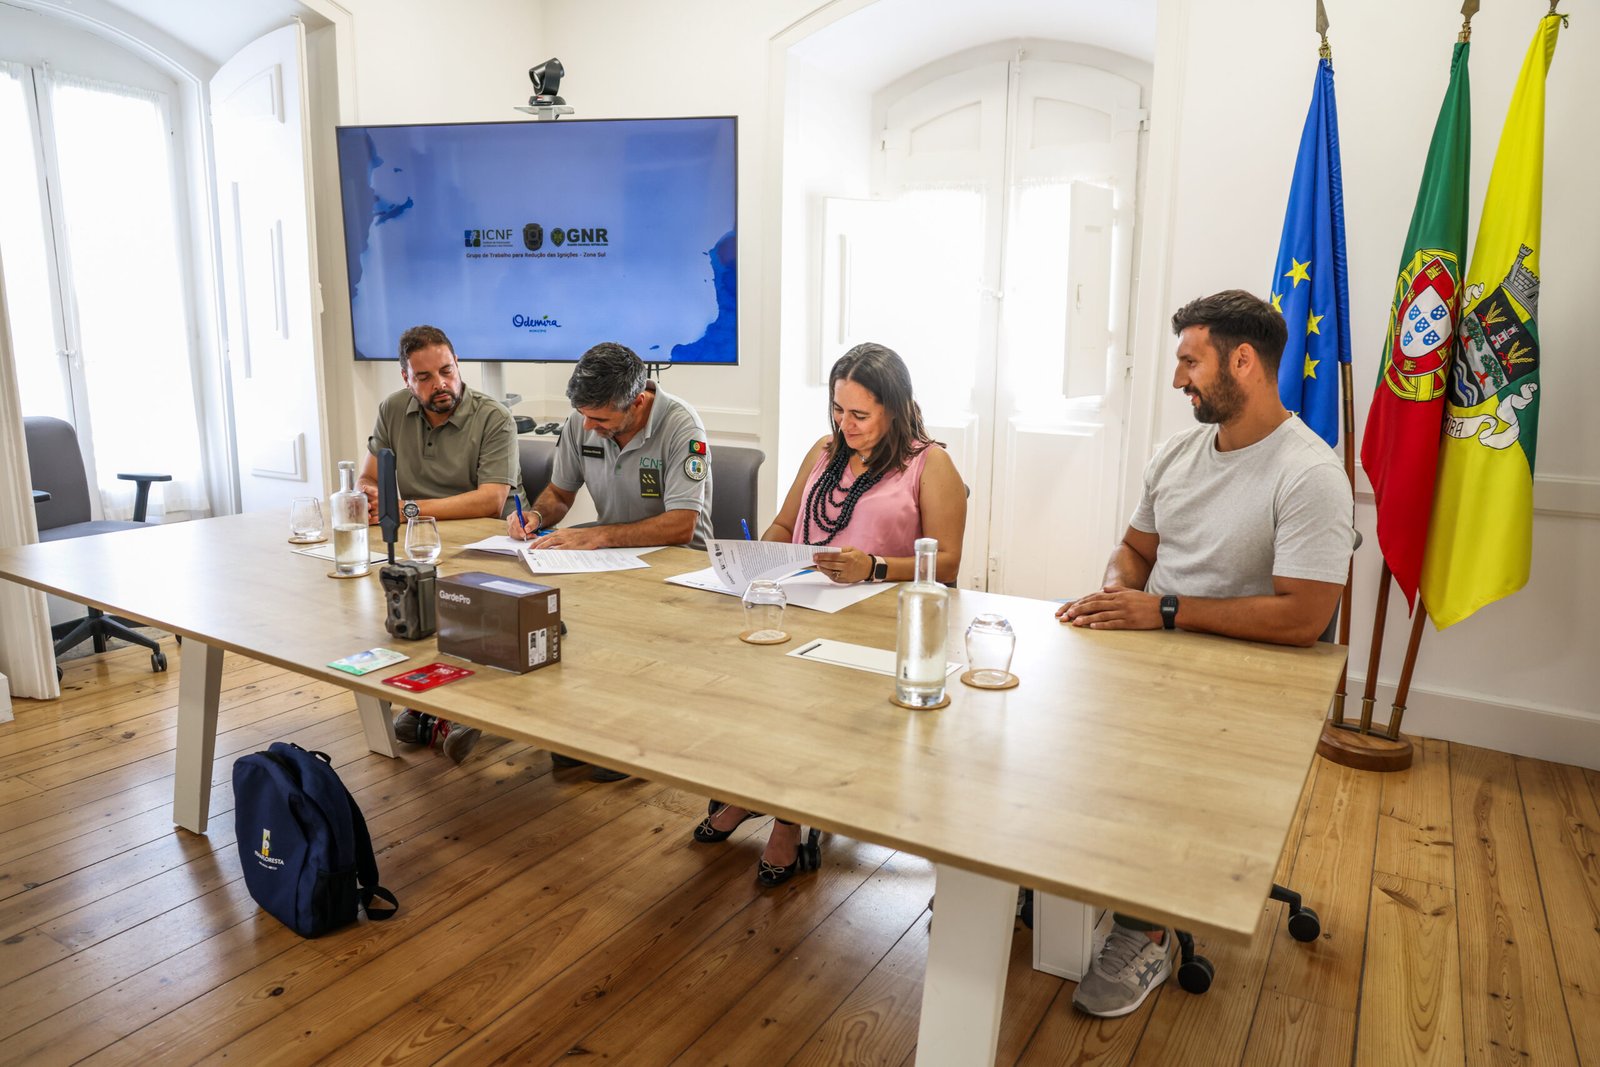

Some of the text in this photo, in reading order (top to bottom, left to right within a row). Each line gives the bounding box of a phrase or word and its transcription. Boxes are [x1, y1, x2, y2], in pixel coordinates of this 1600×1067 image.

[483, 229, 513, 240] ICNF
[567, 228, 608, 242] GNR
[512, 314, 562, 328] Odemira
[439, 590, 471, 605] GardePro
